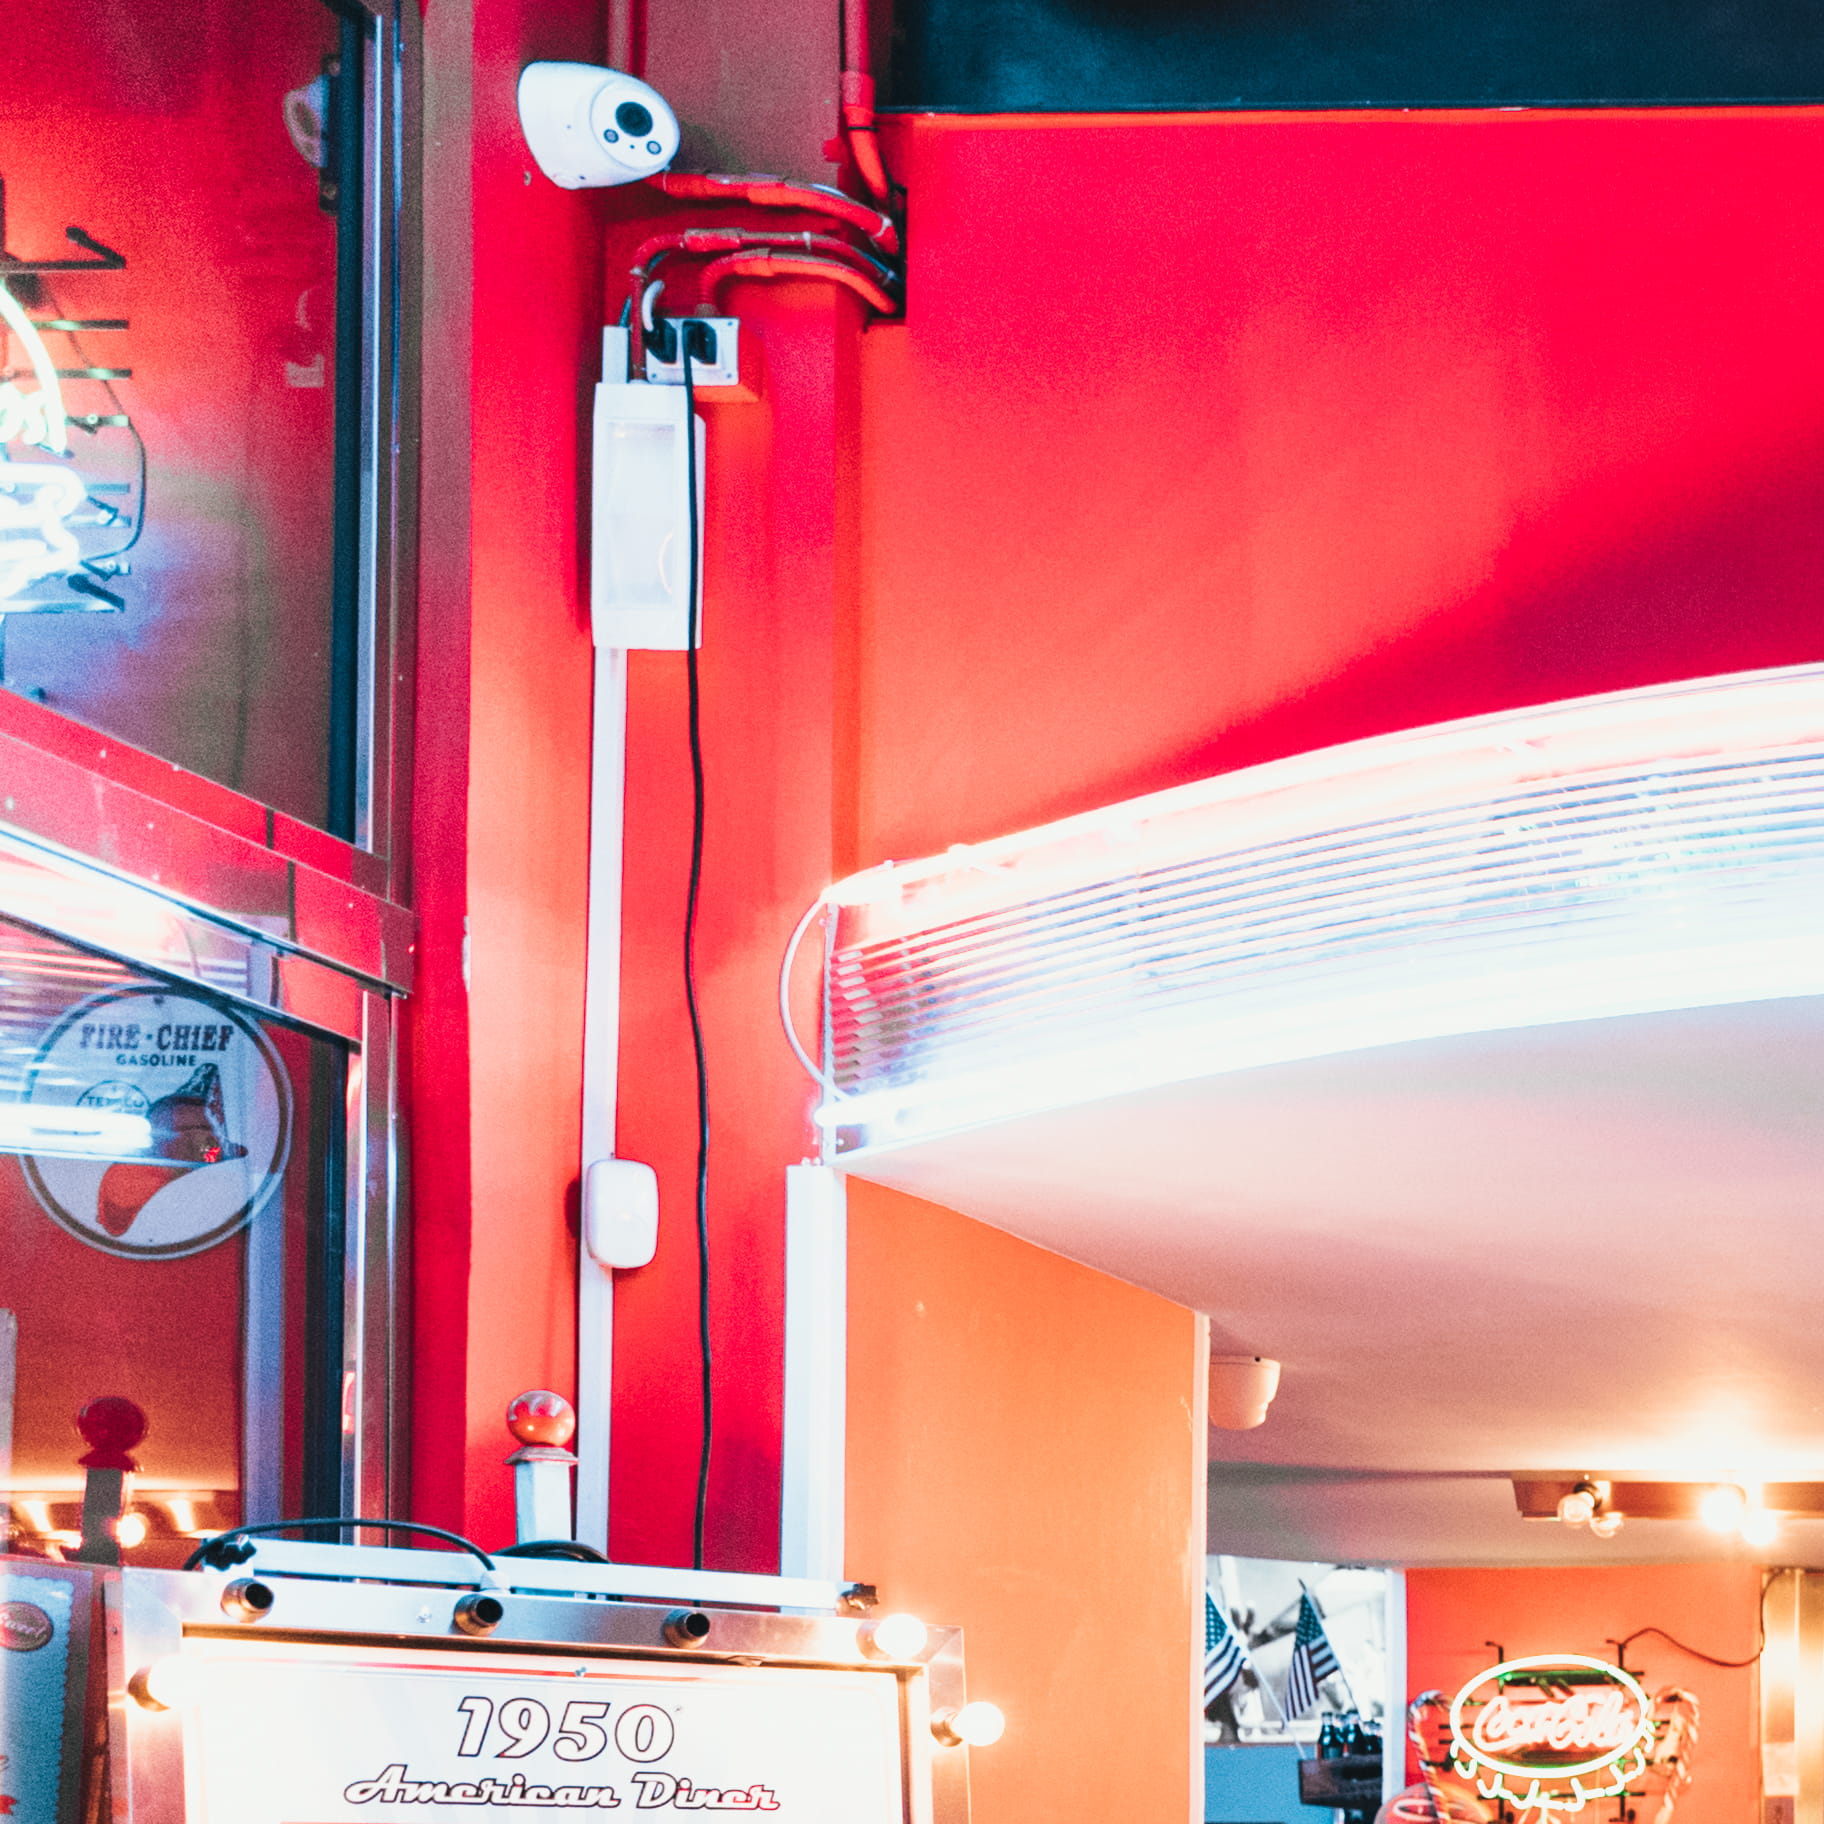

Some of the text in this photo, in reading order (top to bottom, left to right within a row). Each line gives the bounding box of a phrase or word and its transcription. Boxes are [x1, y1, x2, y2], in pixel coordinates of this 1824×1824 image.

[116, 1053, 196, 1067] GASOLINE
[457, 1696, 675, 1763] 1950
[343, 1764, 781, 1811] American Diner
